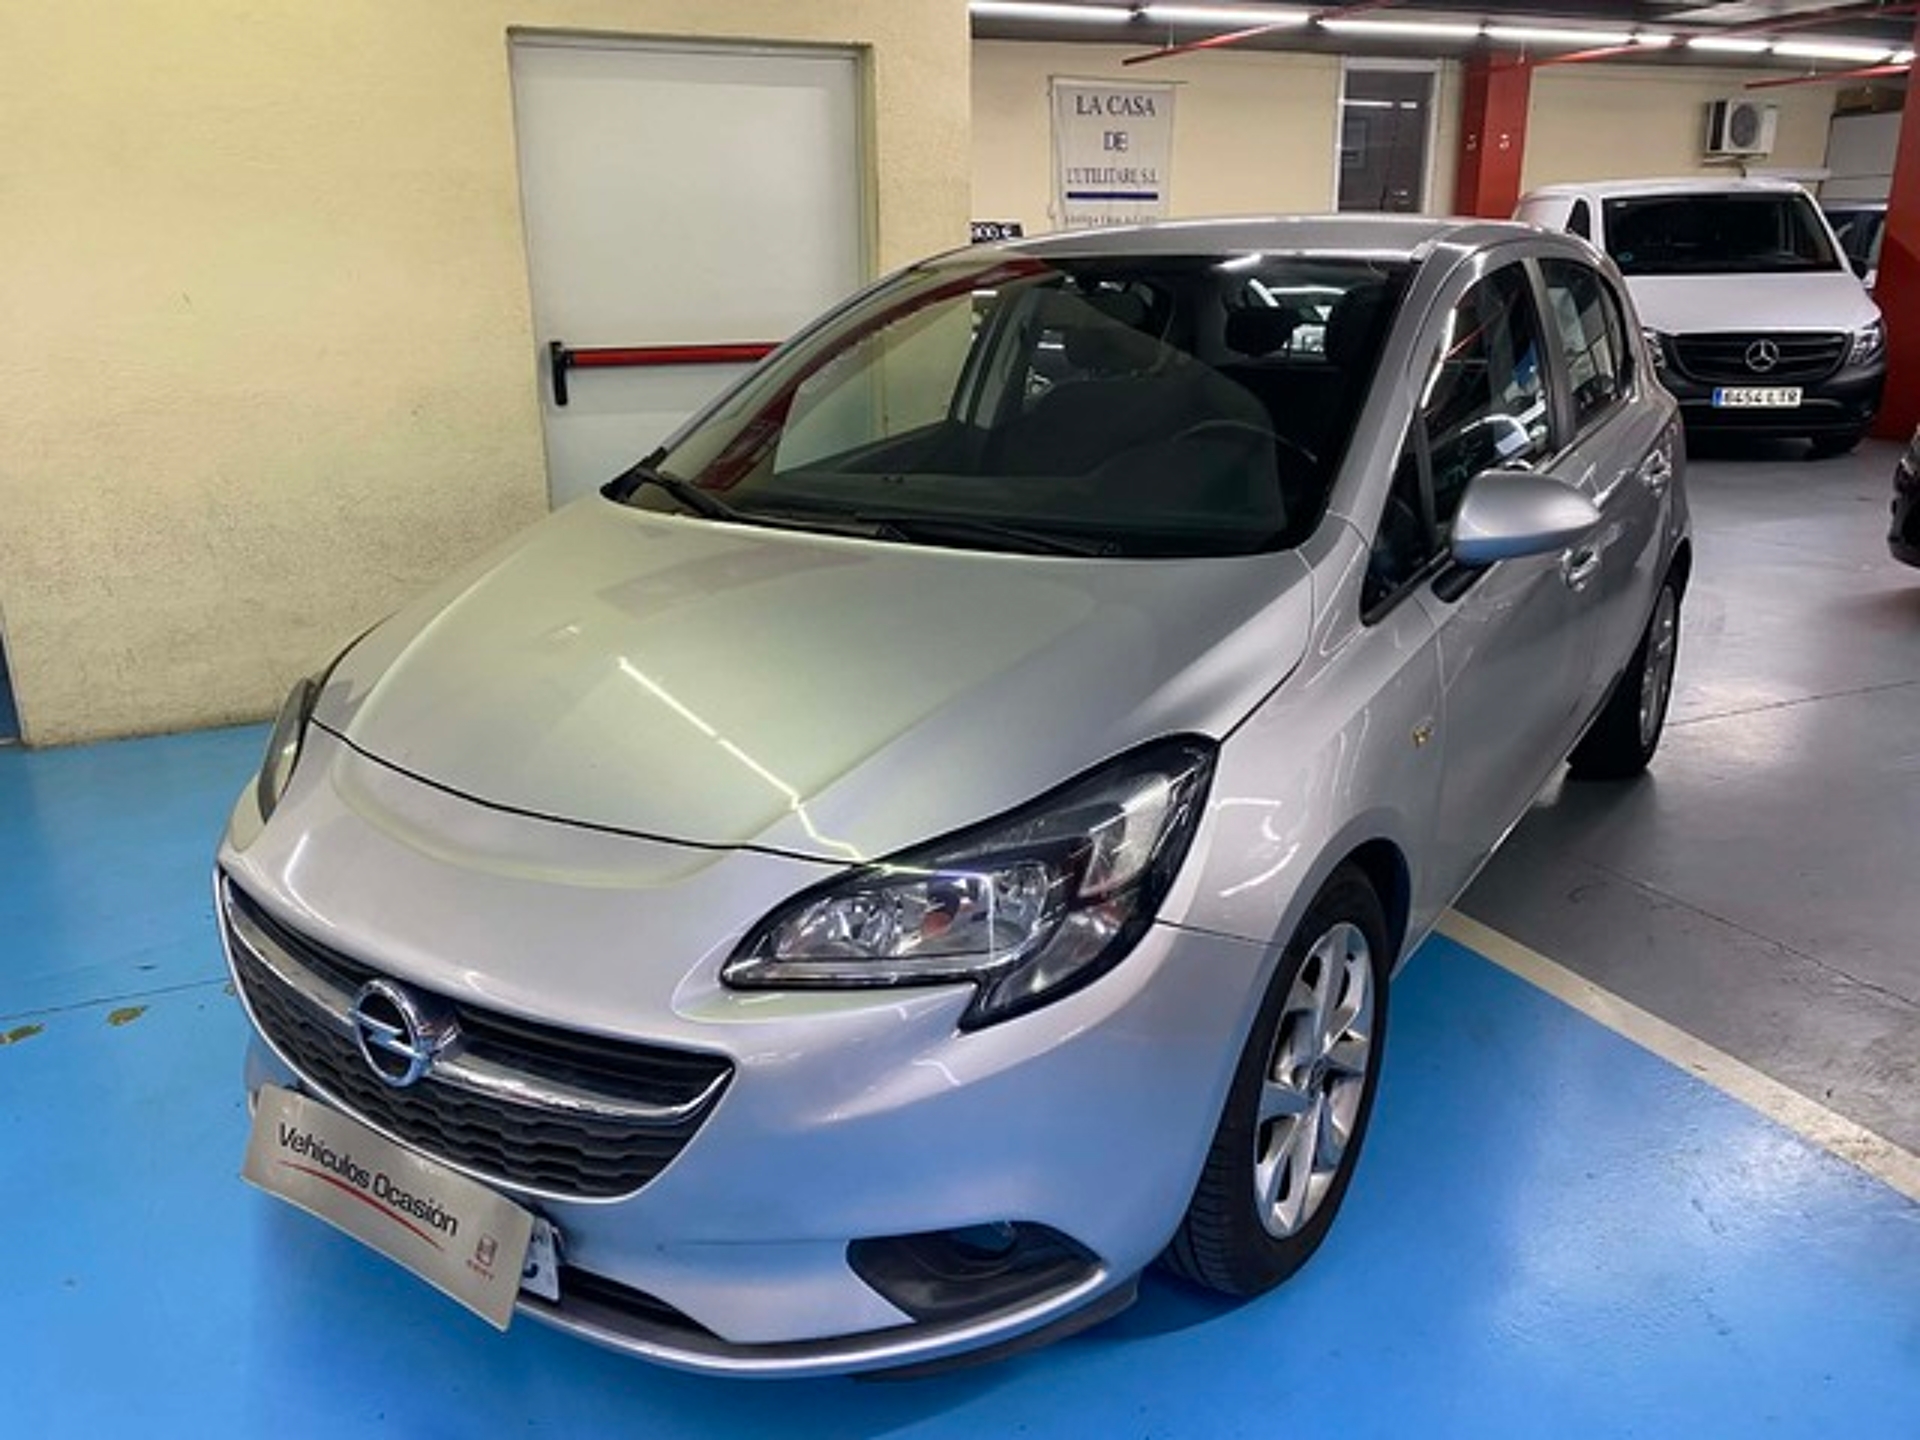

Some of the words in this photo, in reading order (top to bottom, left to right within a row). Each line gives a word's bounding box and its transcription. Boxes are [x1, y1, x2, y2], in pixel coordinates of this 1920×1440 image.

[1076, 94, 1102, 115] LA
[1107, 95, 1156, 117] CASA
[1103, 131, 1128, 151] DE
[372, 1172, 458, 1237] Ocasión
